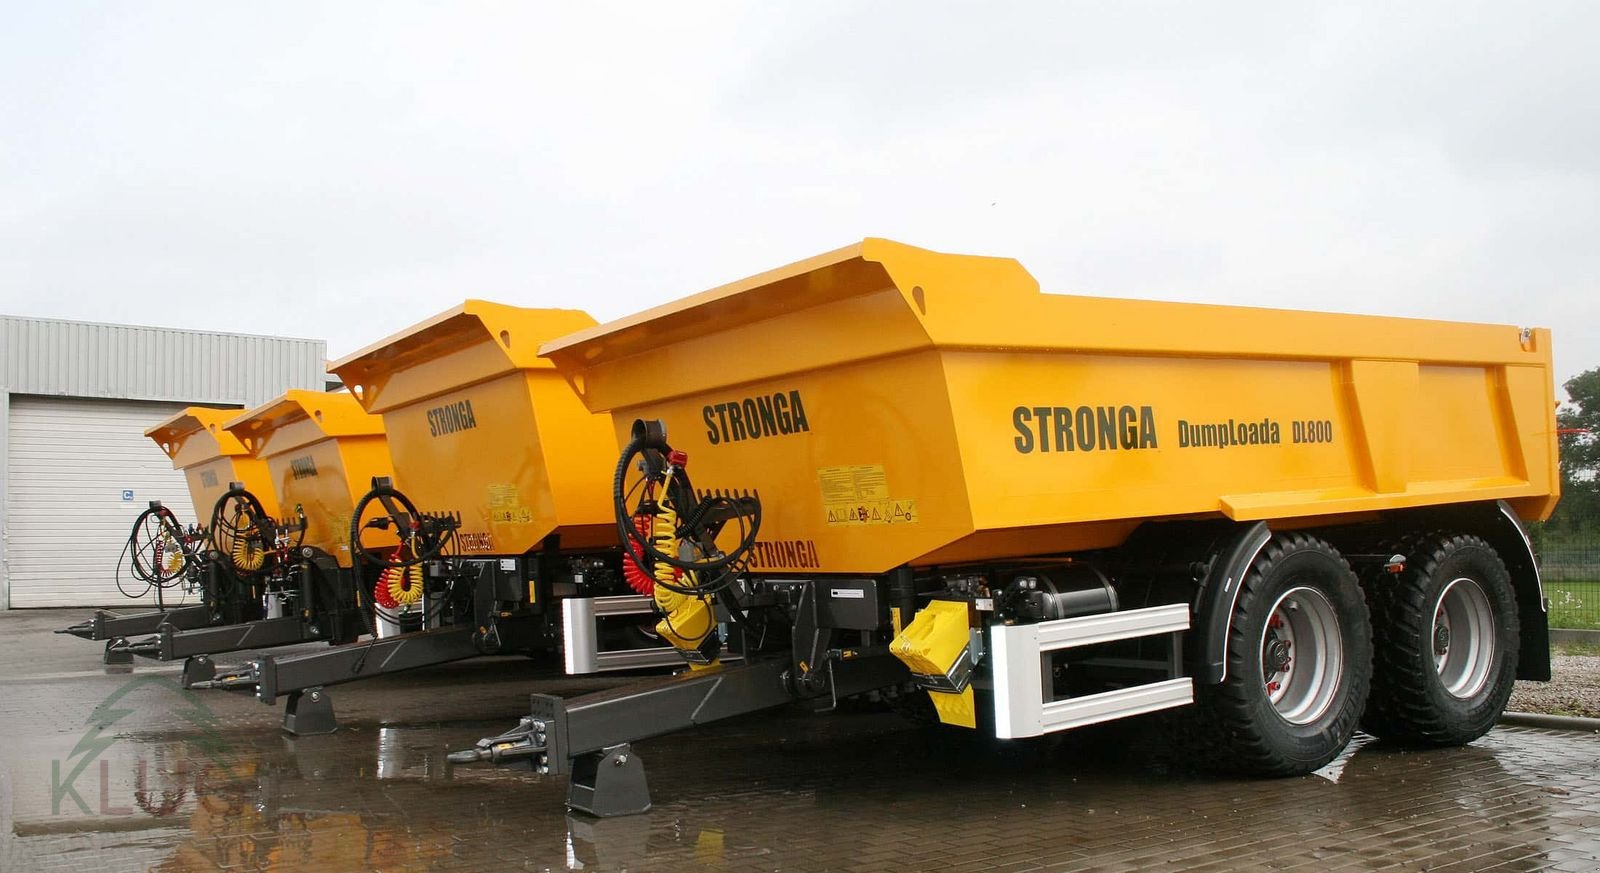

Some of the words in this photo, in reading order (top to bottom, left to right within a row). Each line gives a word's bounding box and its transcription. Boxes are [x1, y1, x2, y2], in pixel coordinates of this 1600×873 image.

[427, 399, 477, 437] STRONGA
[703, 390, 809, 445] STRONGA
[1013, 406, 1158, 453] STRONGA
[1178, 418, 1280, 449] DumpLoada
[1292, 420, 1332, 443] DL800
[750, 540, 820, 568] STRONGA
